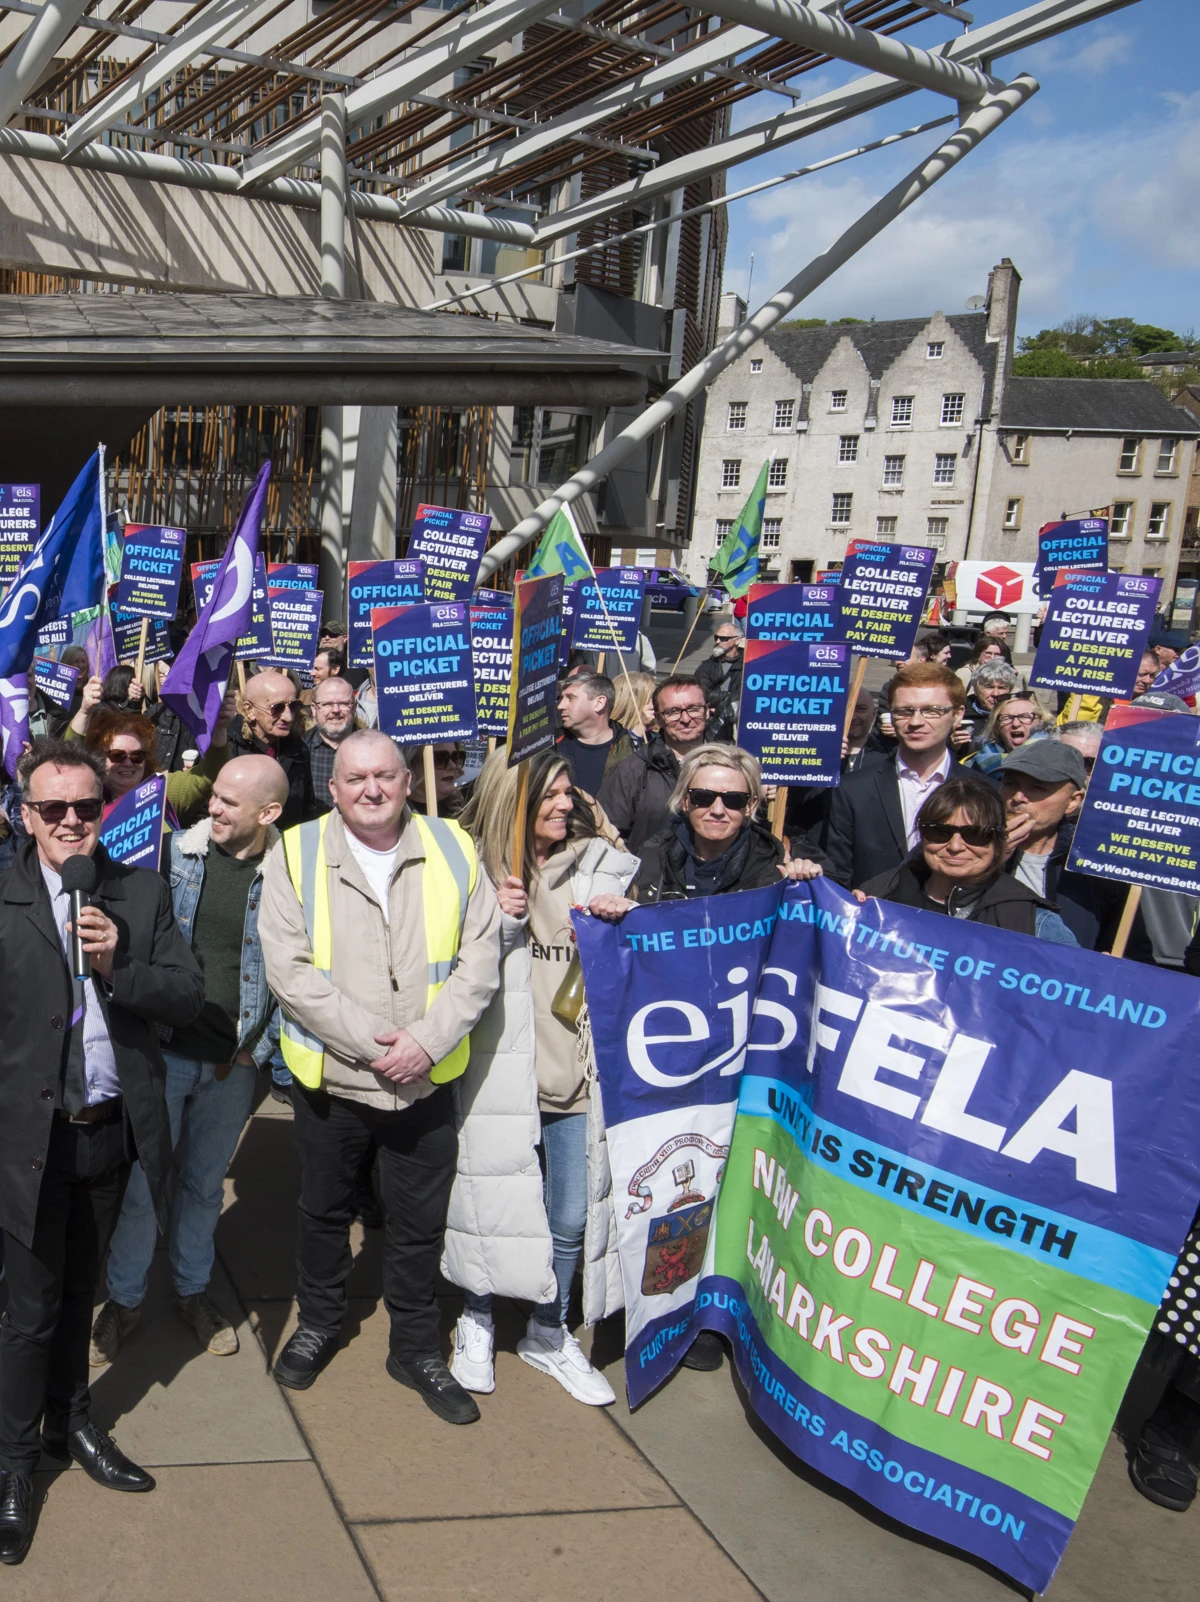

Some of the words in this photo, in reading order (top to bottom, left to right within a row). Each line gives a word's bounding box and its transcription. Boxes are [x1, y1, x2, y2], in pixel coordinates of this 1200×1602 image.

[16, 488, 32, 498] eis
[164, 530, 178, 540] eis
[424, 530, 475, 546] COLLEGE
[1041, 536, 1106, 549] OFFICIAL
[1, 554, 20, 562] FAIR
[125, 544, 181, 560] OFFICIAL
[414, 541, 478, 560] LECTURERS
[906, 548, 926, 561] eis
[1048, 548, 1099, 562] PICKET
[130, 559, 174, 574] PICKET
[420, 554, 467, 570] DELIVER
[427, 568, 470, 582] DESERVE
[855, 566, 918, 583] COLLEGE
[431, 578, 452, 589] FAIR
[845, 579, 923, 598] LECTURERS
[1064, 573, 1107, 584] OFFICIAL
[1125, 578, 1148, 592] eis
[1066, 584, 1101, 593] PICKET
[581, 586, 641, 599] OFFICIAL
[273, 602, 312, 612] COLLEGE
[851, 594, 909, 610] DELIVER
[1066, 598, 1140, 615] COLLEGE
[437, 605, 458, 619] eis
[862, 609, 912, 623] DESERVE
[868, 622, 891, 633] FAIR
[1052, 611, 1145, 630] LECTURERS
[870, 633, 895, 645] RISE
[1059, 627, 1129, 645] DELIVER
[377, 634, 469, 657] OFFICIAL
[816, 647, 838, 659] eis
[1074, 643, 1133, 659] DESERVE
[388, 657, 460, 678] PICKET
[1082, 658, 1109, 670] FAIR
[1084, 668, 1113, 682] RISE
[384, 684, 420, 694] COLLEGE
[422, 680, 468, 691] LECTURERS
[746, 674, 844, 692] OFFICIAL
[1037, 677, 1127, 695] #PayWeDeserveBetter
[409, 693, 443, 702] DELIVER
[416, 705, 453, 714] DESERVE
[756, 697, 833, 715] PICKET
[404, 718, 422, 726] FAIR
[746, 722, 785, 730] COLLEGE
[787, 723, 836, 732] LECTURERS
[391, 730, 472, 743] PayWeDeserveBetter
[1094, 801, 1149, 817] COLLEGE
[1128, 819, 1181, 836] DELIVER
[1132, 837, 1191, 855] DESERVE
[1166, 857, 1197, 870] RISE
[626, 931, 676, 953] THE
[683, 902, 816, 948] EDUCATNAL
[816, 908, 950, 971] INSTITUTE
[955, 954, 994, 979] OF
[998, 966, 1168, 1029] SCOTLAND
[626, 966, 798, 1088] eis
[806, 980, 1118, 1194] FELA
[811, 1127, 843, 1163] IS
[848, 1149, 1079, 1261] STRENGTH
[752, 1147, 801, 1231] NEW
[804, 1207, 1097, 1376] COLLEGE
[639, 1317, 691, 1369] FURTHE
[750, 1341, 827, 1437] LECTURERS
[830, 1429, 1026, 1541] ASSOCIATION
